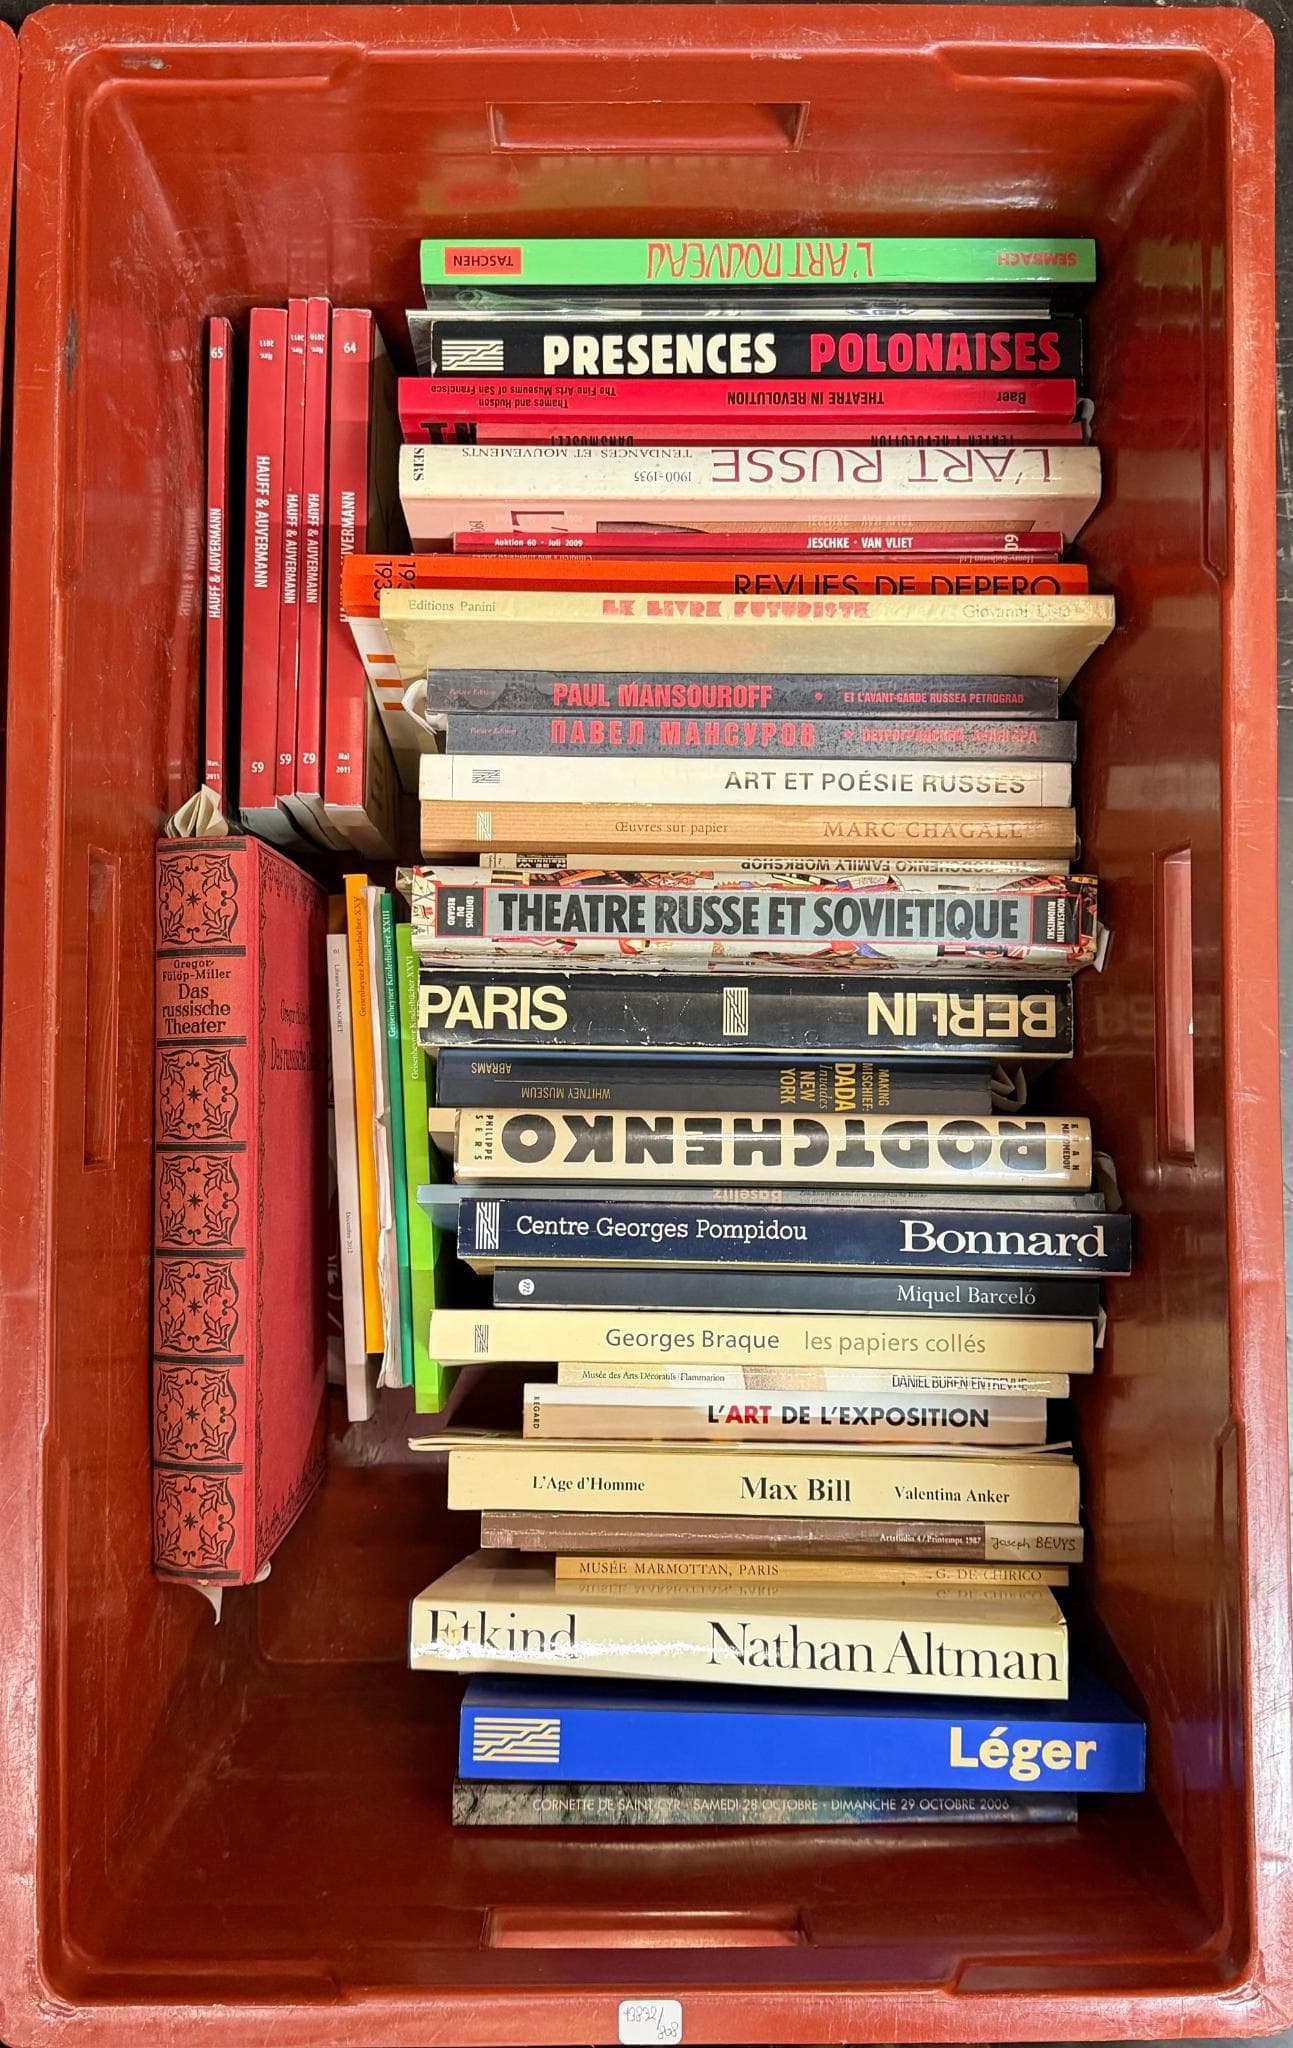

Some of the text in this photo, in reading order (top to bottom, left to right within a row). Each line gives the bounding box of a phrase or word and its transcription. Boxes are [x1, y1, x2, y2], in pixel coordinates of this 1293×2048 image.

[453, 255, 513, 266] TASCHEN
[997, 251, 1077, 267] SEMBACH
[211, 348, 223, 359] 65
[343, 343, 357, 354] 64
[543, 333, 777, 375] PRESENCES
[810, 331, 1061, 373] POLONAISES
[431, 385, 617, 396] The Fine Arts Museums of San Francisco
[727, 391, 885, 405] THEATRE IN REVOLUTION
[996, 391, 1026, 404] Baer
[479, 398, 569, 409] Thames and Hudson
[462, 448, 693, 458] TENDANCES ET MOUVEMENTS
[413, 448, 424, 481] SERS
[711, 449, 1052, 485] L'ART RUSSE
[634, 471, 692, 482] 1900-1935
[254, 455, 271, 588] HAUFF & AUVERMANN
[209, 508, 222, 572] AUVERMANN
[284, 493, 299, 604] HAUFF & AUVERMANN
[306, 493, 320, 603] HAUFF & AUVERMANN
[495, 538, 583, 548] Auktion Juli 2009
[807, 537, 914, 549] JESCHKE VAN VLIET
[208, 585, 221, 618] HAUFF
[408, 600, 496, 612] Editions Panini
[602, 600, 722, 618] LE LIVRE
[962, 604, 1028, 619] Giovanni
[552, 682, 773, 710] PAUL MANSOUROFF
[969, 694, 1024, 704] PETROGRAD
[551, 719, 816, 747] ПАВЕЛ МАНСУРОВ
[251, 762, 265, 773] 65
[279, 753, 292, 765] 65
[303, 753, 317, 764] 62
[724, 769, 1026, 794] ART ET POÉSIE RUSSES
[614, 820, 728, 836] Œuvres sur papier
[823, 821, 1024, 839] MARC CHAGALL
[741, 859, 830, 872] WORKSHOP
[834, 861, 890, 872] FAMILY
[447, 897, 456, 926] REGARD
[456, 906, 465, 917] DU
[465, 895, 474, 929] EDITIONS
[497, 893, 1019, 940] THEATRE RUSSE ET SOVIETIQUE
[1047, 901, 1056, 940] RUDNITSKI
[1056, 898, 1066, 943] KONSTANTIN
[162, 969, 231, 982] Fülöp-Miller
[355, 918, 367, 1017] Geisenheyner Kinderbücher
[381, 910, 398, 1037] Geisenheyner Kinderbücher XXIII
[178, 984, 209, 999] Das
[405, 955, 417, 1029] Kinderbücher XXVI
[162, 1000, 231, 1018] russische
[418, 985, 568, 1031] PARIS
[867, 992, 1056, 1038] BERLIN
[164, 1018, 227, 1035] Theater
[471, 1062, 512, 1074] ABRAMS
[520, 1087, 611, 1099] WHITNEY MUSEUM
[780, 1067, 796, 1105] YORK
[800, 1070, 815, 1102] NEW
[819, 1064, 833, 1110] Invades
[834, 1062, 857, 1112] DADA
[861, 1063, 874, 1112] MISCHIEF:
[878, 1069, 890, 1106] MAKING
[484, 1114, 494, 1161] PHILIPPE
[501, 1113, 1047, 1171] RODTCHENKO
[712, 1188, 783, 1202] Baselitz
[516, 1215, 808, 1244] Centre Georges Pompidou
[899, 1219, 1108, 1258] Bonnard
[896, 1285, 1036, 1309] Miquel Barceló
[605, 1328, 986, 1356] Georges Braque les papiers collés
[582, 1370, 607, 1379] Musée
[608, 1371, 621, 1379] des
[622, 1372, 639, 1380] Arts
[640, 1372, 676, 1381] Décoratifs
[892, 1374, 930, 1389] DANIEL
[708, 1405, 989, 1427] L'ART DE L'EXPOSITION
[532, 1475, 646, 1492] L'Age d'Homme
[740, 1476, 851, 1502] Max Bill
[894, 1485, 1010, 1504] Valentina Anker
[991, 1536, 1030, 1550] Joseph
[579, 1560, 779, 1577] MUSÉE MARMOTTAN, PARIS
[936, 1568, 1042, 1581] G. DE CHIRICO
[427, 1608, 579, 1658] Etkind
[706, 1620, 1063, 1682] Nathan Altman
[950, 1726, 1097, 1782] Léger
[532, 1800, 614, 1810] CORNETTE DE
[693, 1799, 819, 1810] SAMEDI 28 OCTOBRE
[831, 1799, 1010, 1811] DIMANCHE 29 OCTOBRE 2006
